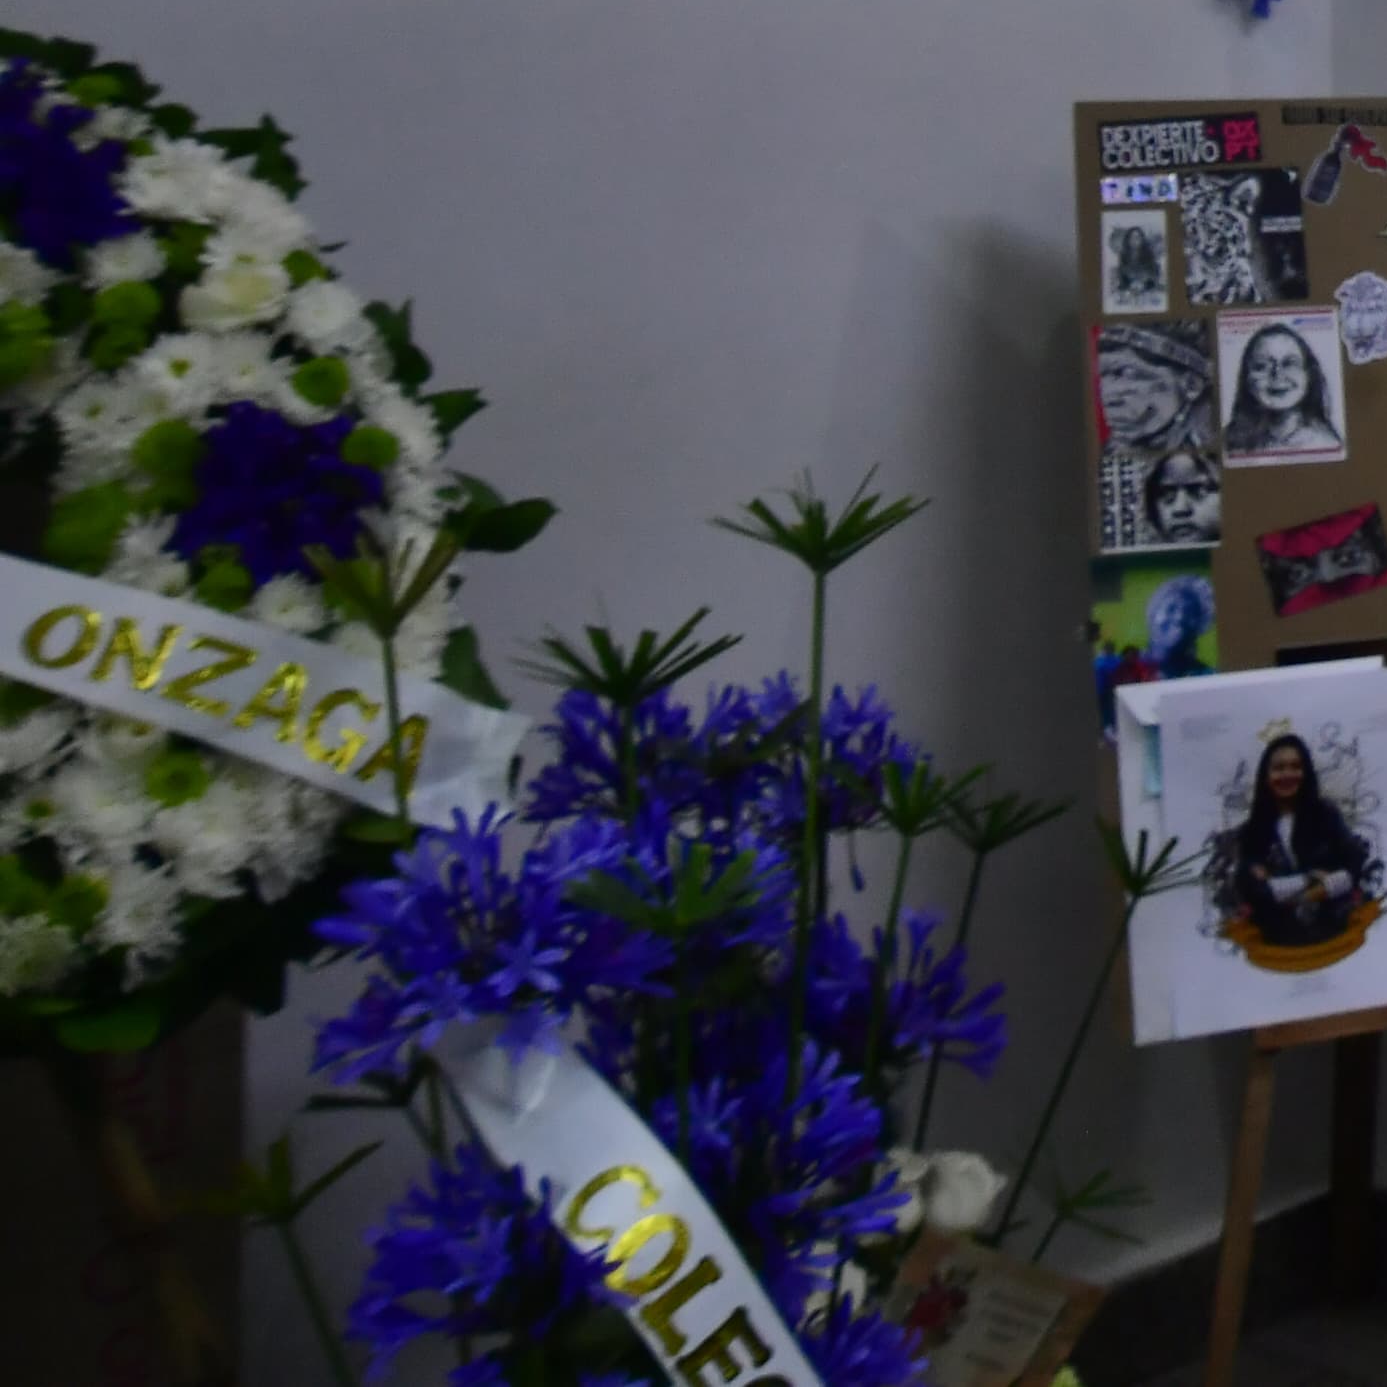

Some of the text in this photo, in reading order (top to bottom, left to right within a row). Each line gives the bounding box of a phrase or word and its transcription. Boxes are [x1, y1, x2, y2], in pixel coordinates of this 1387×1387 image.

[1103, 140, 1220, 170] COLECTIVO
[22, 604, 431, 801] ONZAGA
[565, 1165, 793, 1387] COLE
